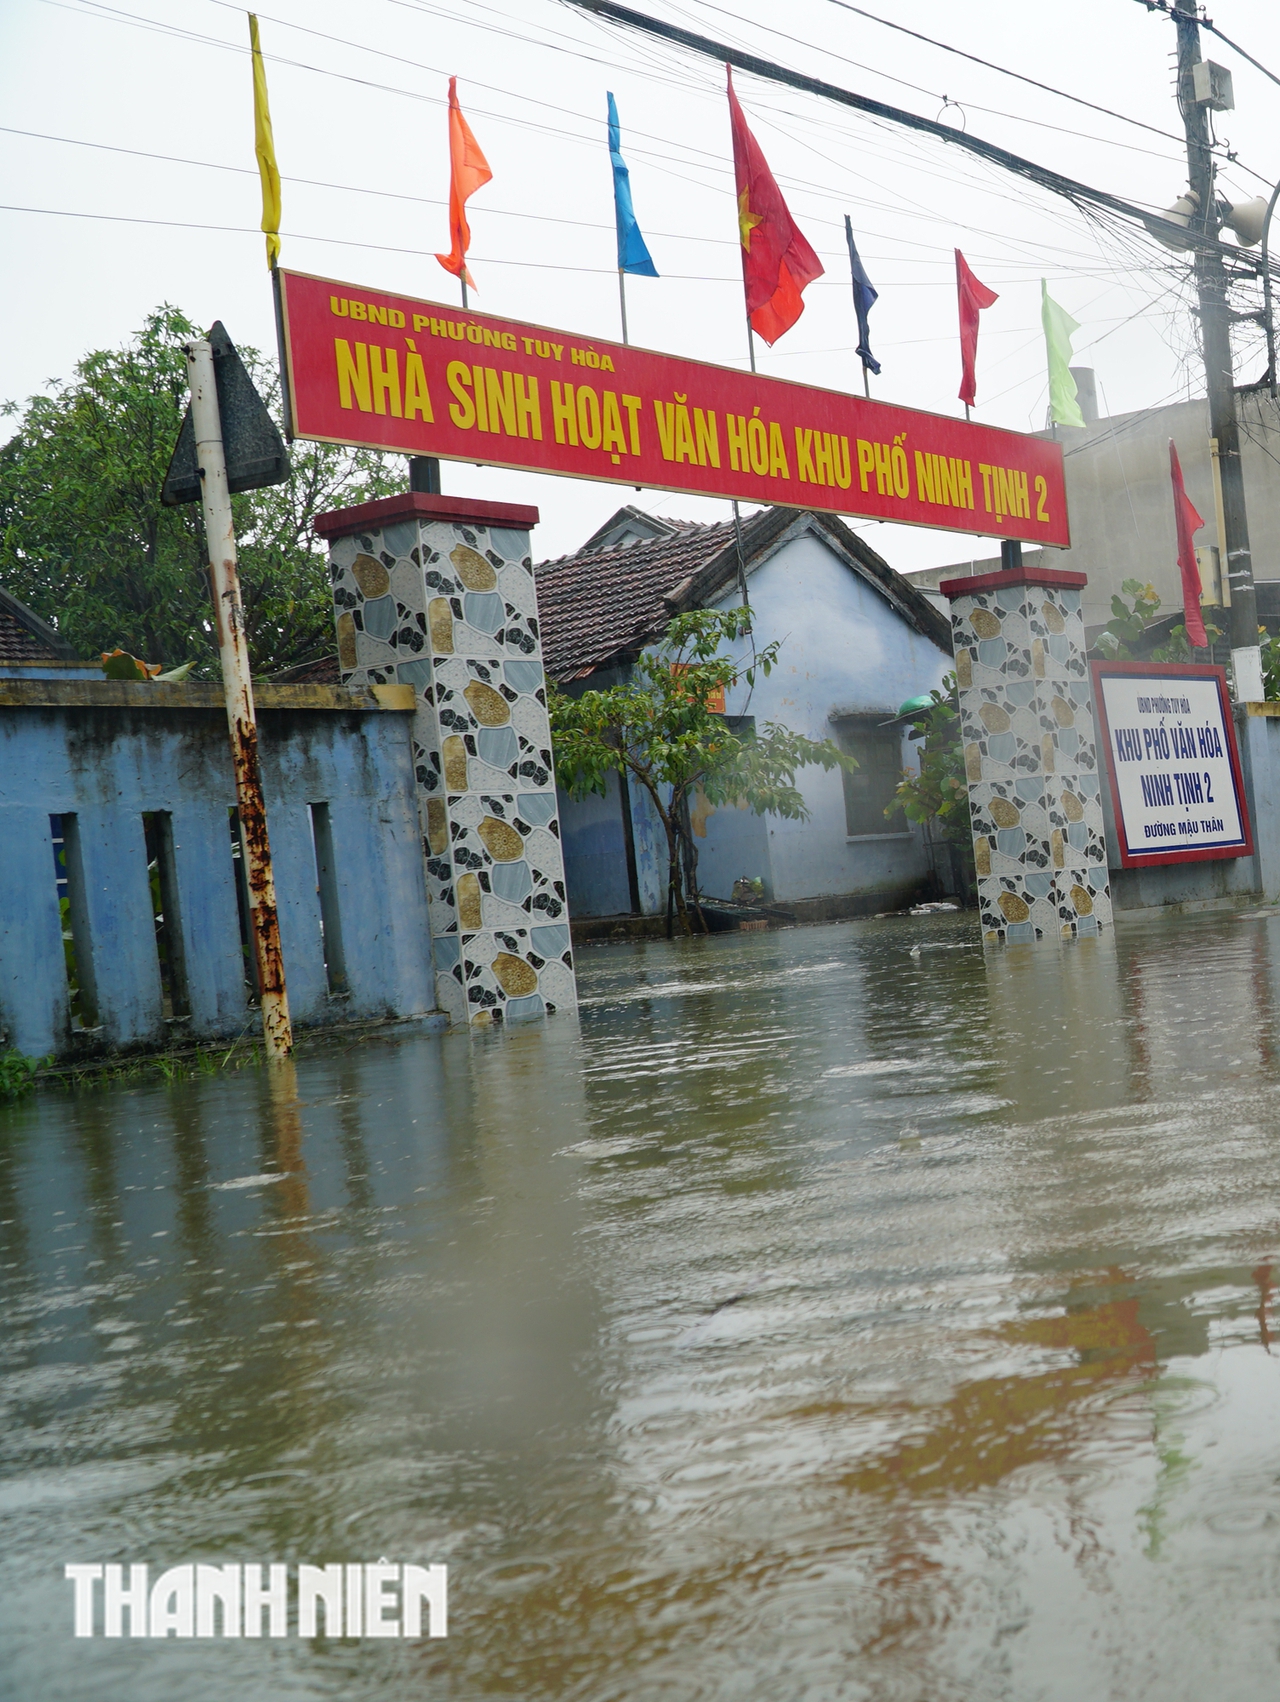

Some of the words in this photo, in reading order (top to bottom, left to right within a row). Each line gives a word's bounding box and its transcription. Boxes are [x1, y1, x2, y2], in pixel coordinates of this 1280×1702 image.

[330, 296, 406, 329] UBND
[412, 314, 517, 351] PHƯỜNG
[521, 337, 564, 362] TUY
[571, 345, 615, 373] HÒA
[334, 338, 435, 423] NHÀ
[447, 361, 543, 441] SINH
[550, 380, 642, 465] HOẠT
[653, 392, 720, 469] VĂN
[726, 406, 790, 480] HÓA
[795, 427, 852, 490] KHU
[857, 432, 910, 499] PHỐ
[914, 450, 975, 510] NINH
[979, 463, 1031, 523] TỊNH
[1034, 475, 1050, 523] 2
[1115, 728, 1142, 762] KHU
[1144, 716, 1170, 760] PHỐ
[1170, 720, 1197, 759] VĂN
[1197, 720, 1224, 759] HÓA
[1140, 774, 1174, 807] NINH
[1174, 772, 1204, 812] TỊNH
[1204, 772, 1214, 803] 2
[1144, 820, 1177, 838] ĐƯỜNG
[1178, 817, 1199, 837] MẬU
[1200, 816, 1224, 833] THÂN
